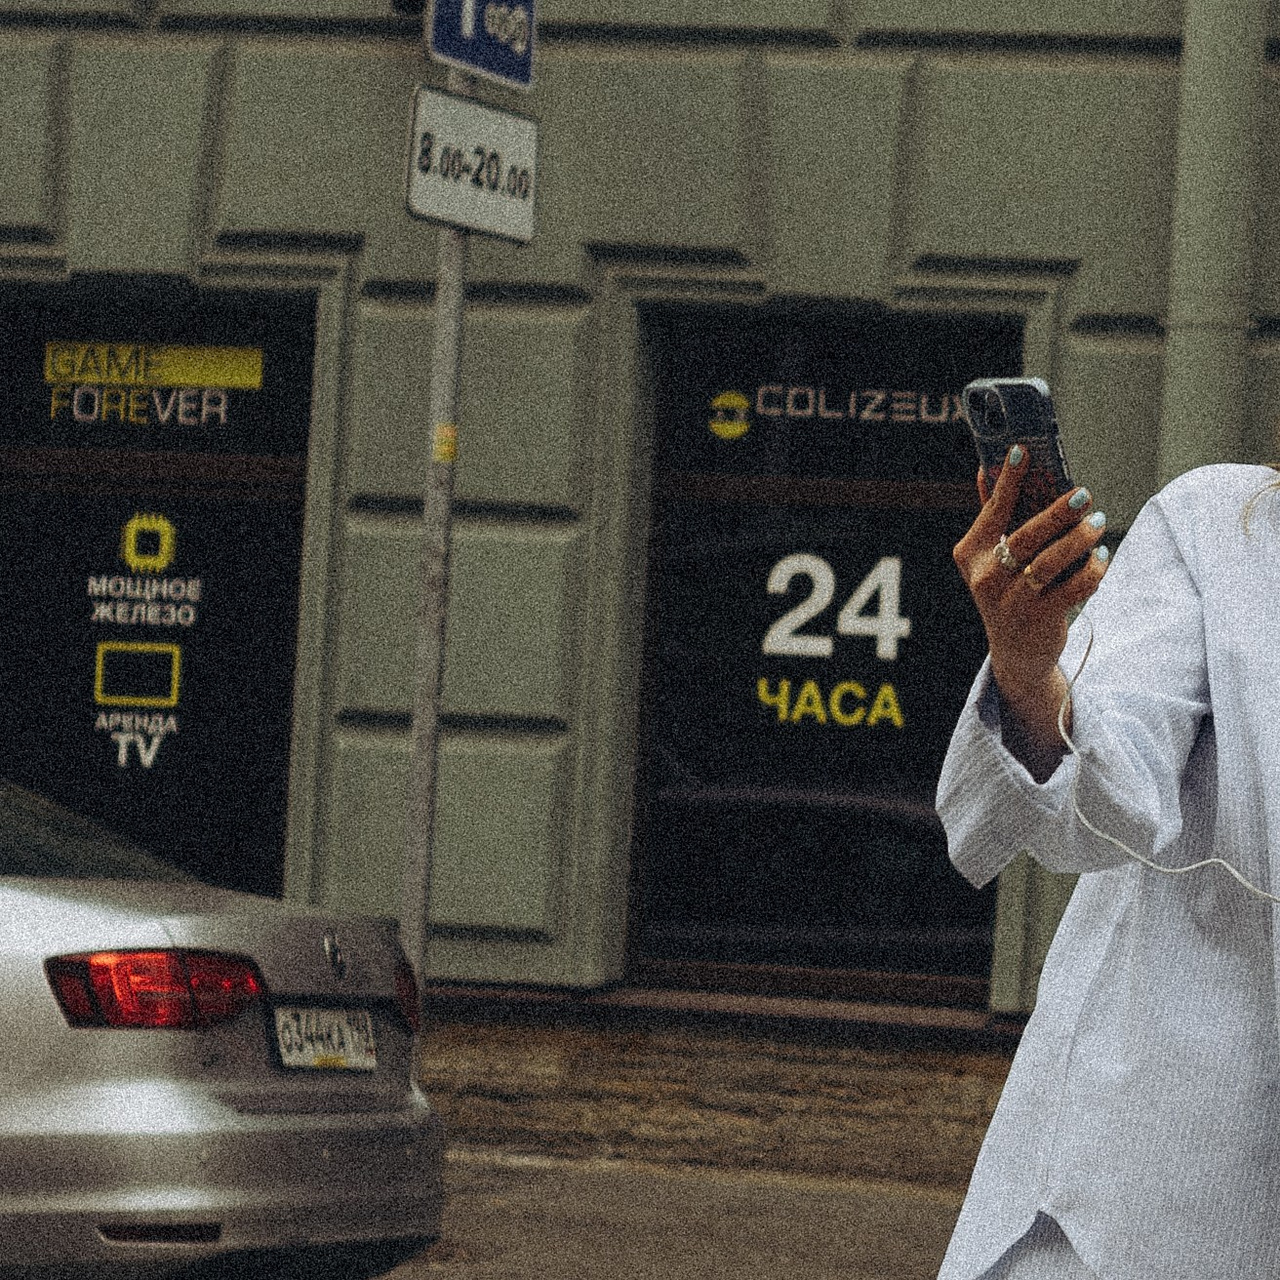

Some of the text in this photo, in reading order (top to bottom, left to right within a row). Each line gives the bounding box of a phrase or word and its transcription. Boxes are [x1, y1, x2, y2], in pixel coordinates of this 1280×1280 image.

[50, 344, 163, 382] GAME
[49, 385, 229, 426] FOREVER
[87, 576, 202, 601] МОЩНОЕ
[762, 553, 911, 660] 24
[91, 601, 197, 627] ЖЕЛЕЗО
[757, 677, 904, 728] ЧАСА
[95, 712, 179, 734] АРЕНДА
[111, 733, 163, 769] TV
